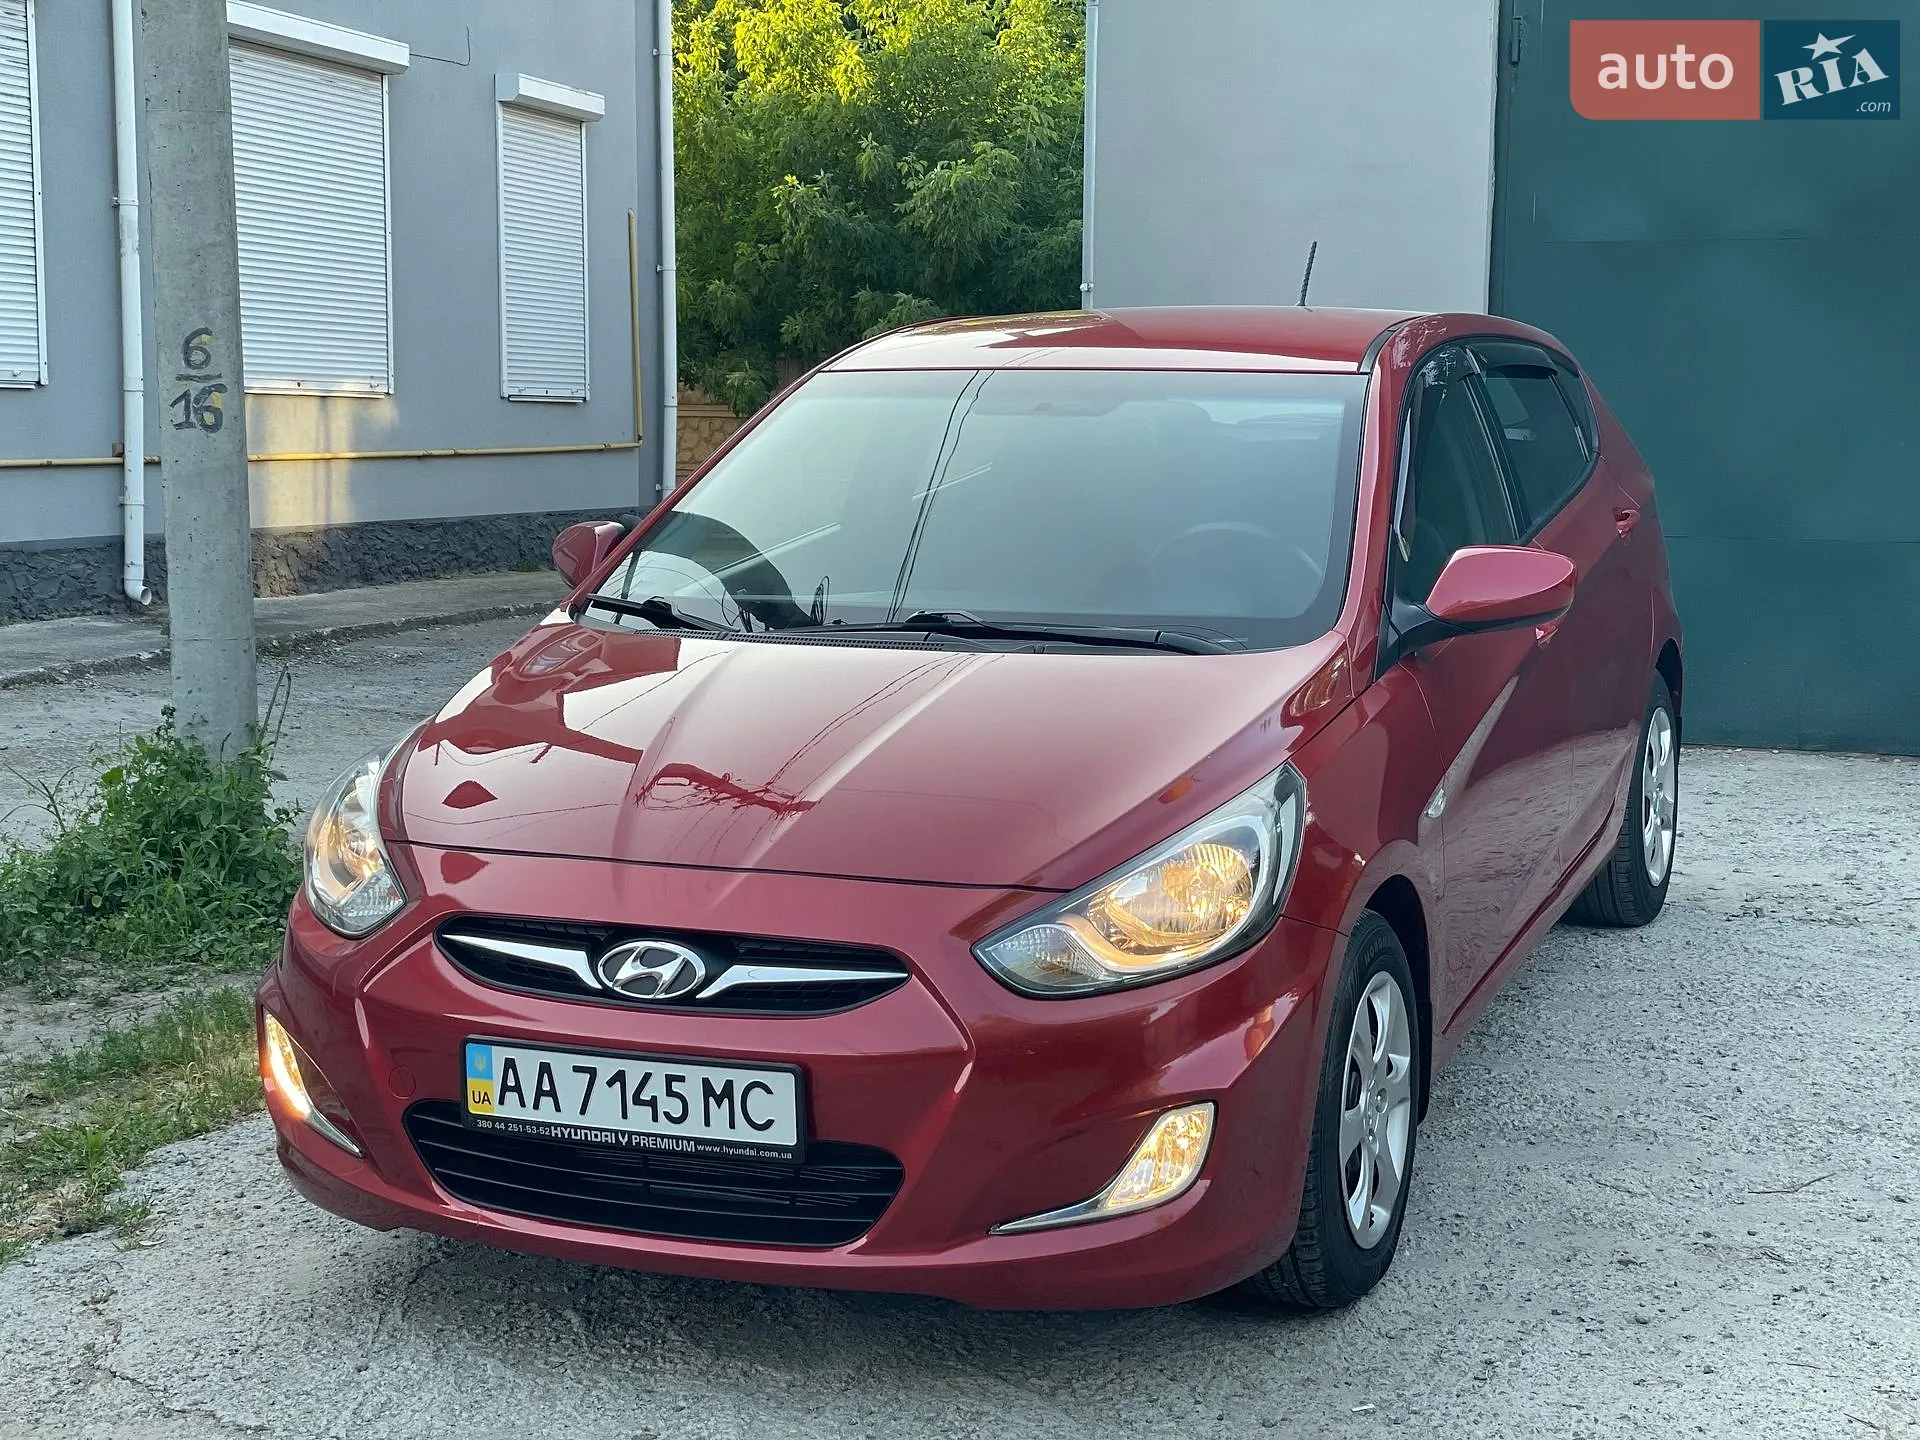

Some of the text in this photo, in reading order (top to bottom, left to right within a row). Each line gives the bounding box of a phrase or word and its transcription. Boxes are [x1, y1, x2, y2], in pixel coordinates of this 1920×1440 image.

[182, 326, 213, 370] 6
[168, 383, 228, 434] 16
[471, 1089, 492, 1106] UA
[497, 1056, 776, 1132] AA 7145 MC
[476, 1119, 492, 1129] 380
[494, 1121, 506, 1130] 44
[551, 1125, 616, 1144] HYUNDAI
[632, 1134, 696, 1152] PREMIUM
